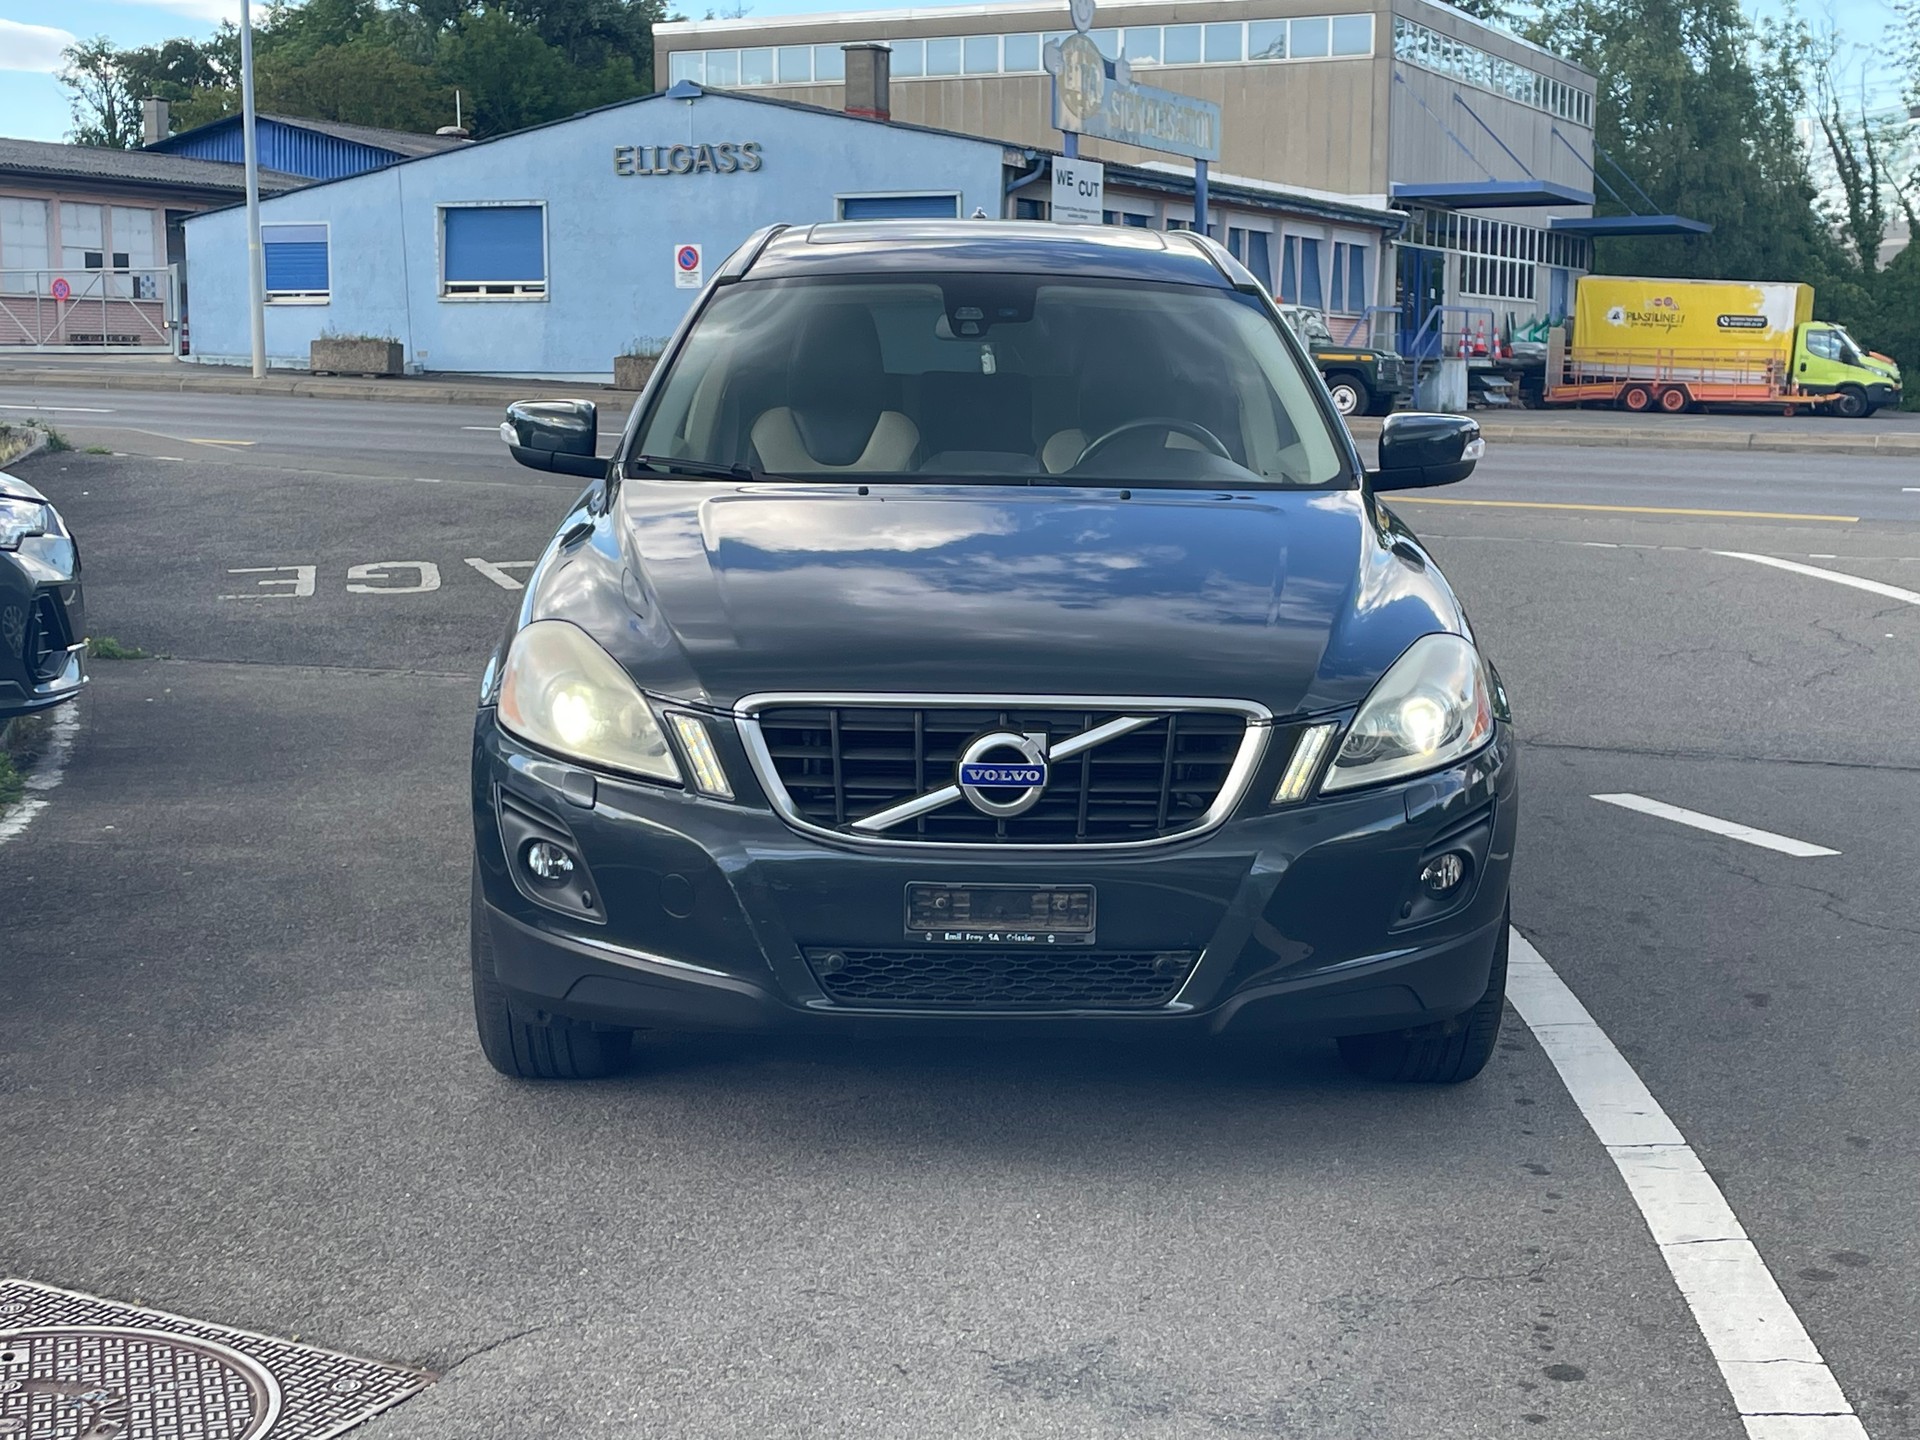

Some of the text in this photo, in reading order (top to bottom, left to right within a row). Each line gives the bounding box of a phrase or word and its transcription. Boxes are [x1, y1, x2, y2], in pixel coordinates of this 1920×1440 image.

[614, 142, 762, 176] ELLGASS
[1056, 169, 1100, 198] WE CUT
[966, 769, 1040, 782] VOLVO
[944, 932, 962, 941] Emil
[966, 933, 983, 942] Frey
[988, 933, 1000, 941] SA
